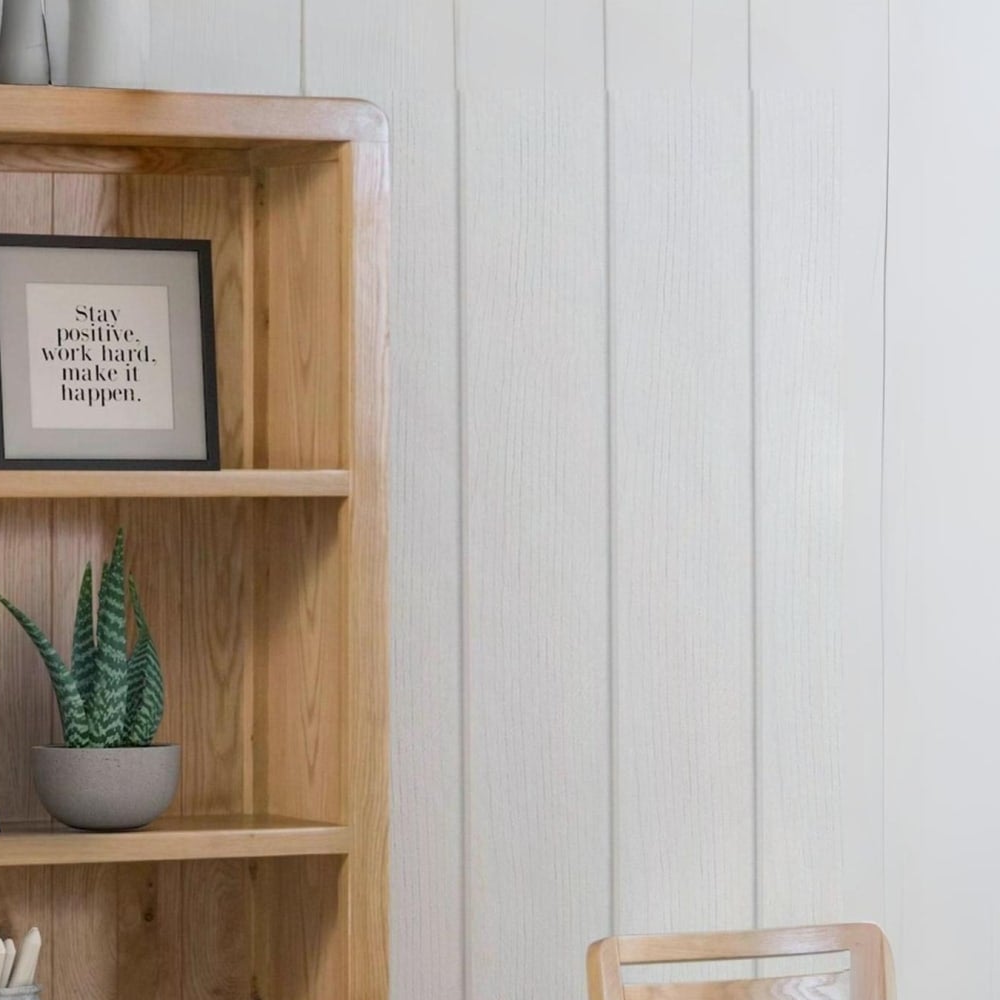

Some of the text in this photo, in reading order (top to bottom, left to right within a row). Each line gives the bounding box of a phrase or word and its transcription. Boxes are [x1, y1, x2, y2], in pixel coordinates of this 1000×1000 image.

[75, 305, 120, 325] Stay
[42, 344, 92, 361] work
[62, 363, 138, 382] make it
[61, 384, 141, 407] happen.
